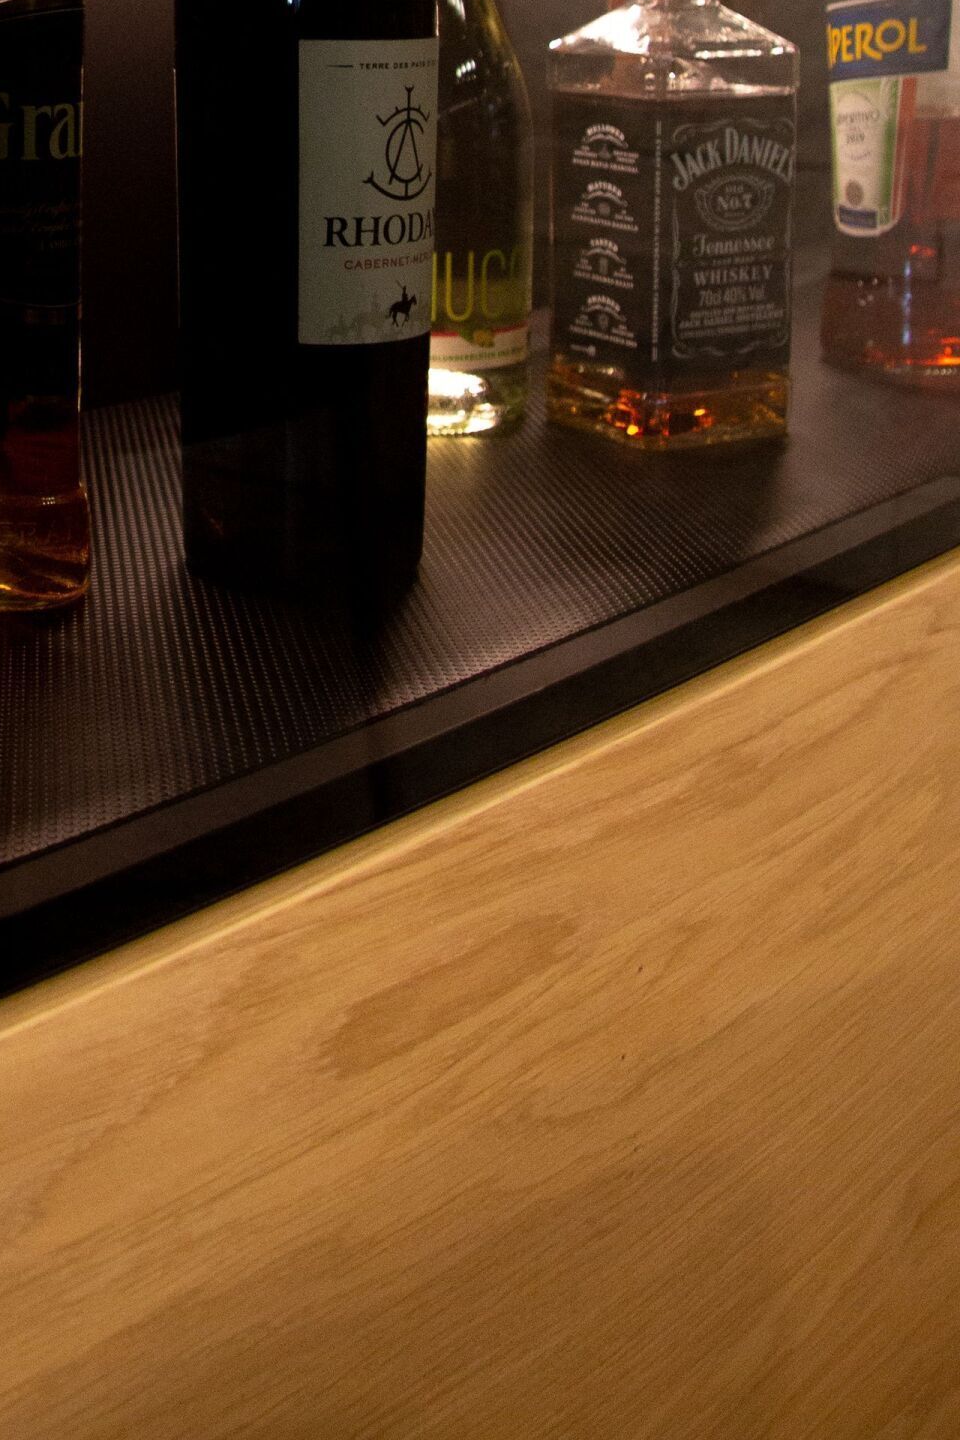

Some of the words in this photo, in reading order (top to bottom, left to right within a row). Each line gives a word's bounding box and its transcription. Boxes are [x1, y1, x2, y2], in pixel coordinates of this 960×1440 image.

[359, 62, 390, 70] TERRE
[670, 137, 723, 191] JACK
[322, 208, 435, 248] RHODA
[691, 232, 776, 257] Tennessee
[693, 264, 774, 287] WHISKEY
